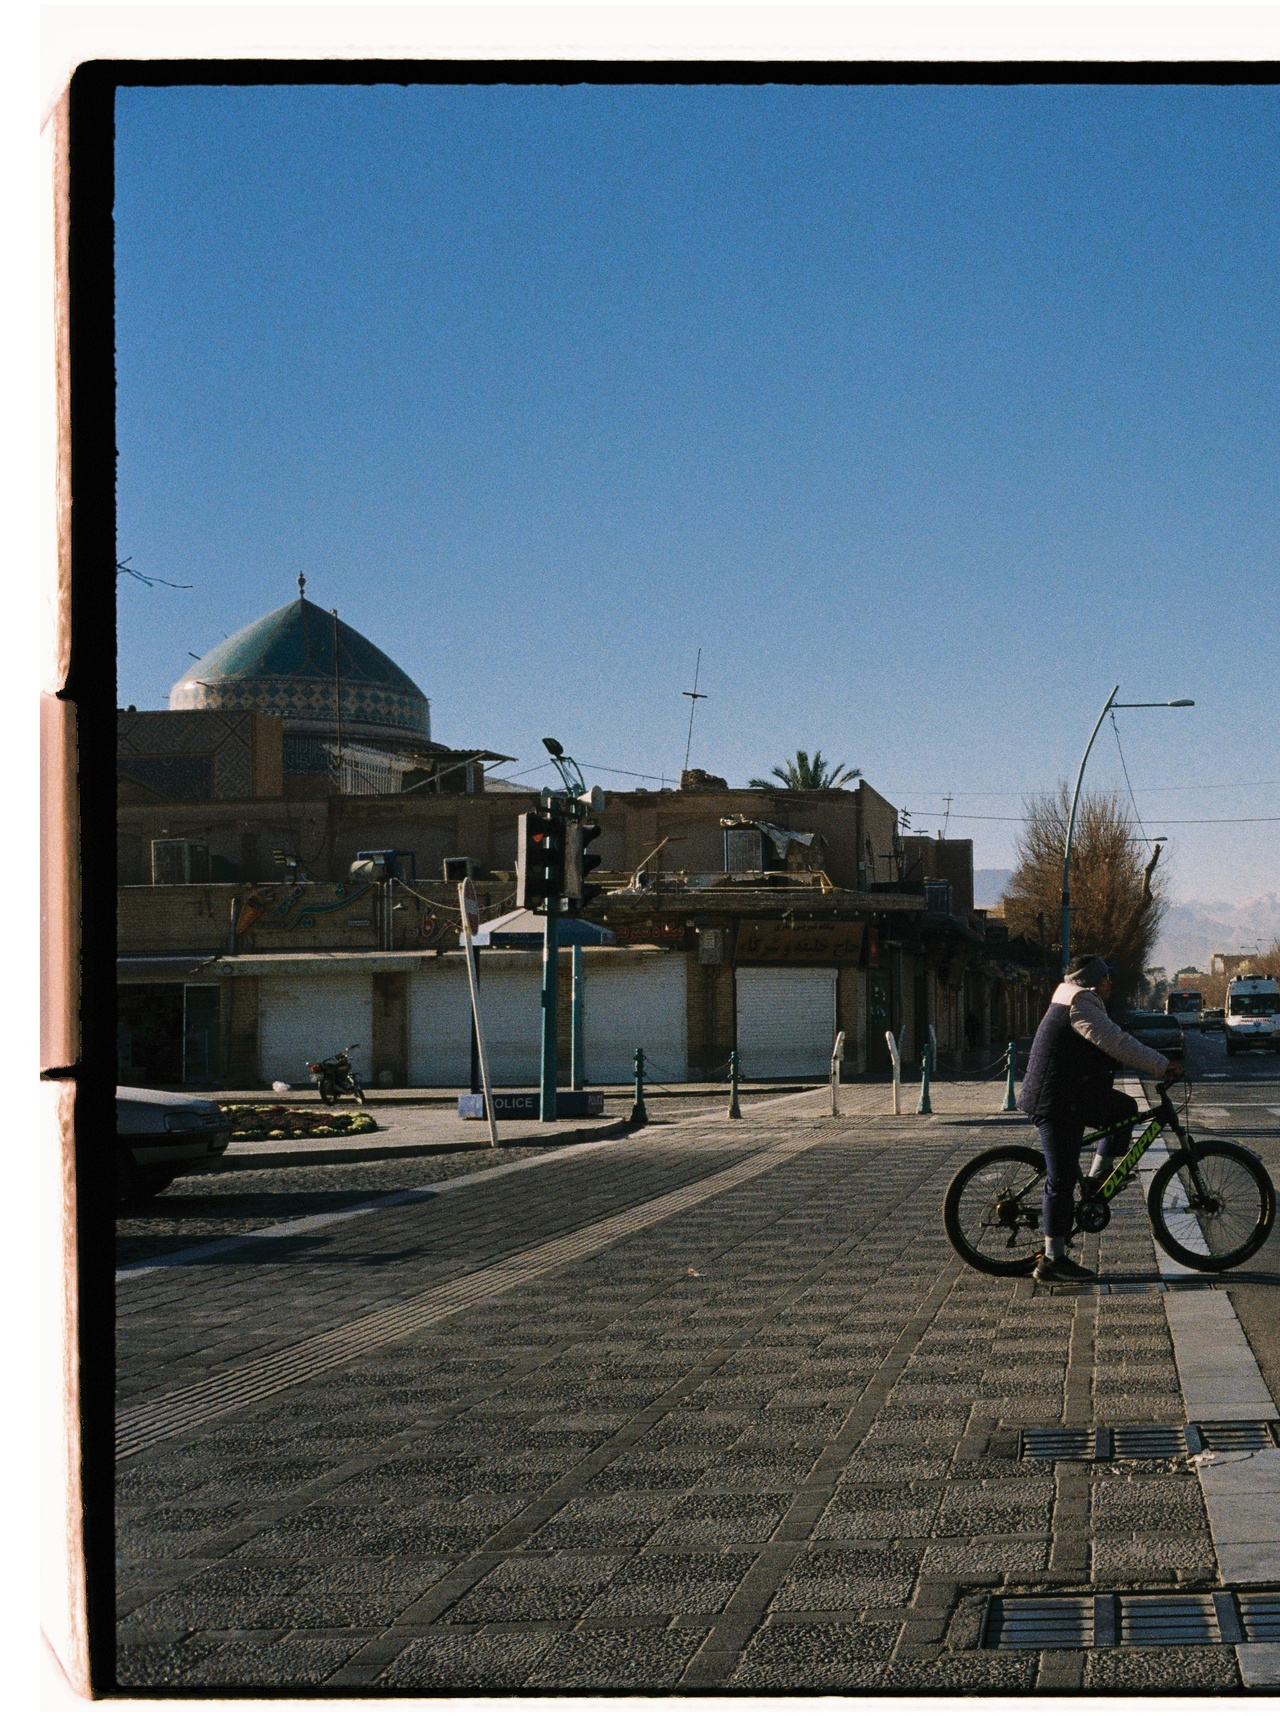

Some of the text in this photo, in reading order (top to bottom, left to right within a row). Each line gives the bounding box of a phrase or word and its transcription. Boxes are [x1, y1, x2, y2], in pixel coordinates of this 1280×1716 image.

[782, 944, 790, 957] و
[795, 937, 829, 957] خلیفه
[833, 939, 859, 957] حاج
[493, 1097, 533, 1109] OLICE
[1103, 1120, 1162, 1198] OLYMPIA
